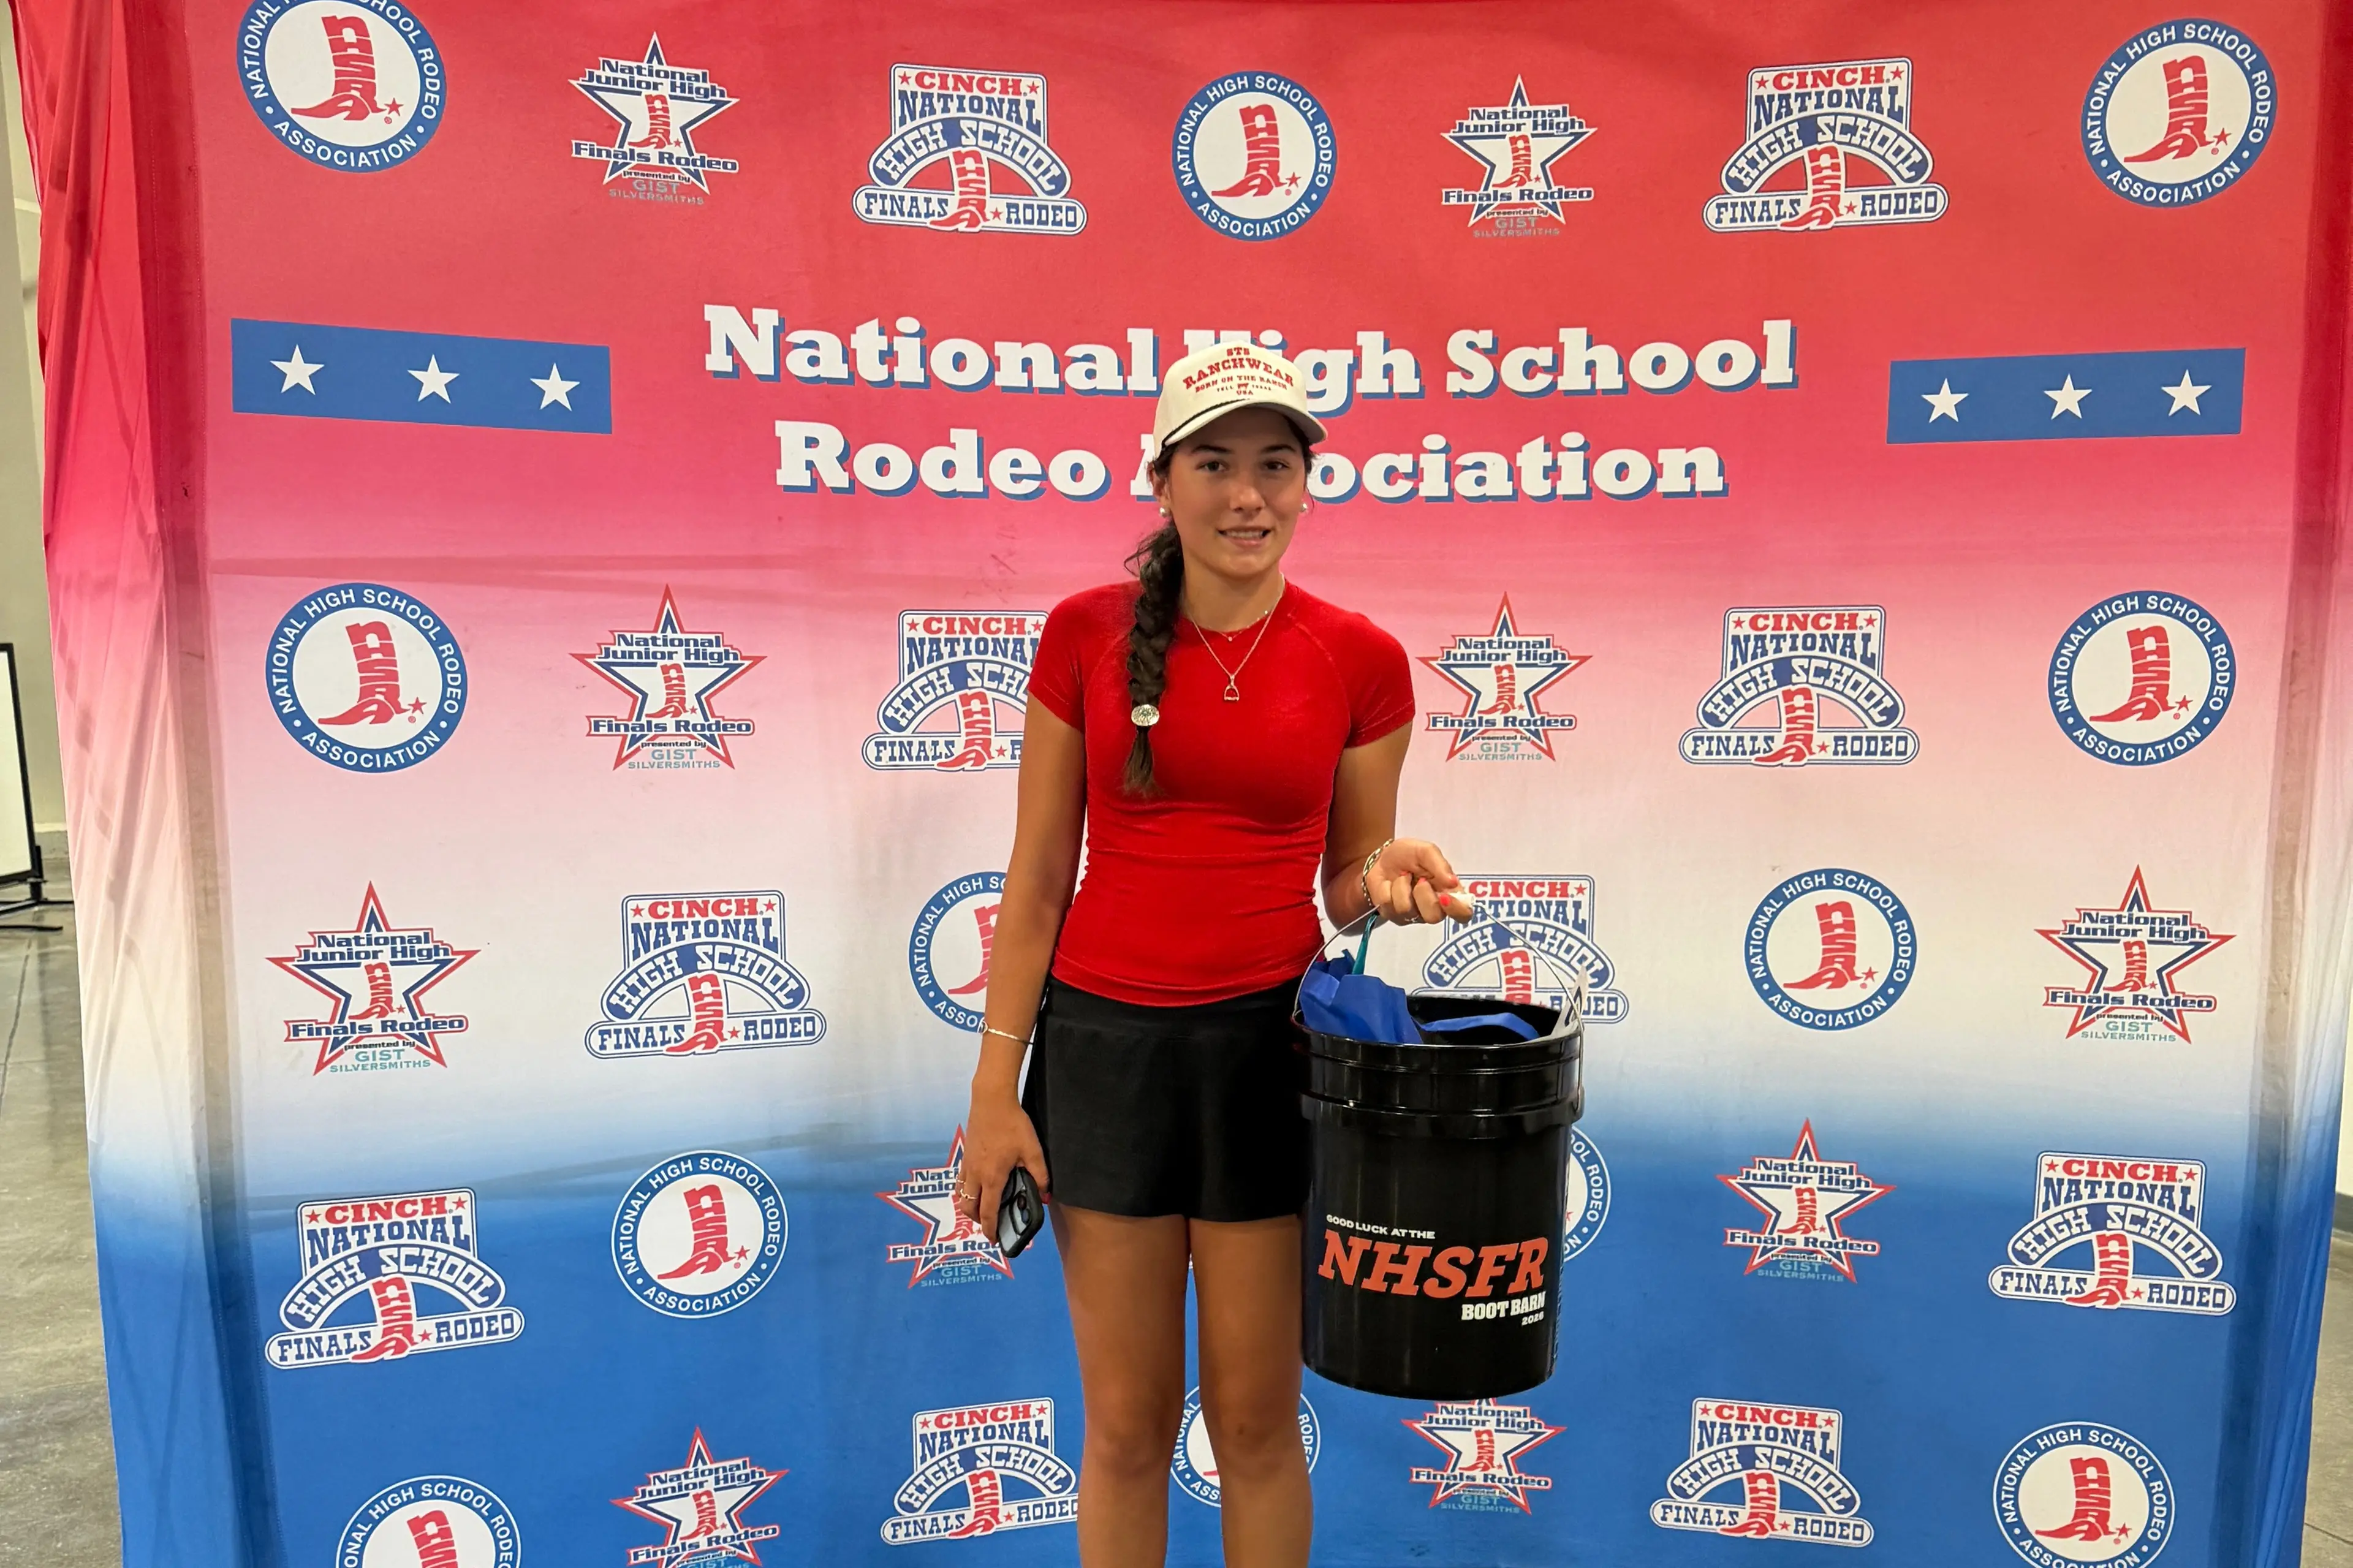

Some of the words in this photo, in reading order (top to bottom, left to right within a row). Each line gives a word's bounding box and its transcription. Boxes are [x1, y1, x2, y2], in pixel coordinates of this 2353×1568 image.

[418, 47, 440, 119] RODEO
[582, 71, 663, 91] Junior
[670, 82, 726, 99] High
[602, 59, 707, 83] National
[915, 70, 1021, 97] CINCH
[1773, 66, 1885, 90] CINCH
[2086, 62, 2126, 155] NATIONAL
[2126, 26, 2175, 59] HIGH
[2183, 24, 2258, 69] SCHOOL
[2249, 70, 2271, 142] RODEO
[898, 89, 1040, 137] NATIONAL
[1471, 107, 1567, 121] National
[1755, 86, 1903, 132] NATIONAL
[1176, 102, 1208, 186] NATIONAL
[1207, 76, 1248, 102] HIGH
[1255, 75, 1318, 121] SCHOOL
[1315, 123, 1332, 187] RODEO
[1453, 123, 1526, 134] Junior
[1533, 119, 1584, 132] High
[273, 121, 417, 166] ASSOCIATION
[575, 142, 650, 162] Finals
[659, 152, 737, 172] Rodeo
[876, 123, 947, 181] HIGH
[960, 120, 1061, 192] SCHOOL
[1729, 123, 1802, 187] HIGH
[1817, 115, 1923, 178] SCHOOL
[1444, 190, 1512, 202] Finals
[1519, 189, 1592, 201] Rodeo
[2107, 162, 2240, 202] ASSOCIATION
[865, 194, 948, 216] FINALS
[1006, 203, 1077, 227] RODEO
[1197, 203, 1311, 236] ASSOCIATION
[1715, 199, 1800, 224] FINALS
[1861, 191, 1938, 216] RODEO
[705, 305, 1158, 391] National
[1447, 320, 1793, 393] School
[1183, 358, 1294, 389] RANCHWEAR
[1195, 379, 1218, 392] BORN
[1259, 376, 1287, 390] RANCH
[775, 422, 1106, 496] Rodeo
[1748, 613, 1859, 631] CINCH
[273, 619, 306, 714] NATIONAL
[304, 589, 355, 618] HIGH
[363, 589, 442, 640] SCHOOL
[439, 643, 461, 713] RODEO
[598, 647, 678, 660] Junior
[684, 650, 738, 664] High
[617, 634, 721, 648] National
[1458, 638, 1551, 649] National
[1730, 634, 1875, 671] NATIONAL
[2053, 626, 2091, 712] NATIONAL
[2091, 597, 2139, 624] HIGH
[2146, 596, 2218, 642] SCHOOL
[2209, 644, 2230, 710] RODEO
[1440, 651, 1510, 661] Junior
[1517, 651, 1567, 664] High
[1705, 664, 1777, 722] HIGH
[1792, 659, 1894, 722] SCHOOL
[594, 720, 667, 732] Finals
[675, 721, 751, 732] Rodeo
[1431, 716, 1497, 727] Finals
[1504, 716, 1573, 727] Rodeo
[303, 731, 440, 768] ASSOCIATION
[651, 749, 696, 760] GIST
[1691, 736, 1775, 756] FINALS
[1833, 736, 1908, 756] RODEO
[2073, 727, 2201, 761] ASSOCIATION
[648, 898, 758, 919] CINCH
[2083, 912, 2188, 926] National
[317, 932, 430, 947] National
[631, 918, 778, 960] NATIONAL
[1749, 899, 1783, 979] NATIONAL
[1783, 874, 1826, 898] HIGH
[1833, 873, 1899, 918] SCHOOL
[1893, 920, 1912, 982] RODEO
[2062, 924, 2142, 937] Junior
[2149, 928, 2206, 941] High
[297, 950, 383, 962] Junior
[391, 945, 449, 960] High
[610, 951, 683, 1014] HIGH
[695, 945, 799, 1005] SCHOOL
[1769, 994, 1887, 1026] ASSOCIATION
[2051, 991, 2125, 1005] Finals
[2132, 994, 2213, 1009] Rodeo
[292, 1022, 373, 1037] Finals
[381, 1018, 464, 1032] Rodeo
[599, 1025, 684, 1050] FINALS
[744, 1017, 816, 1040] RODEO
[2082, 1031, 2176, 1042] SILVERSMITHS
[2105, 1020, 2153, 1032] GIST
[330, 1060, 430, 1072] SILVERSMITHS
[355, 1049, 404, 1062] GIST
[1740, 1170, 1812, 1184] Junior
[1819, 1176, 1871, 1190] High
[1758, 1159, 1854, 1175] National
[2062, 1159, 2178, 1183] CINCH
[324, 1196, 446, 1225] CINCH
[2043, 1176, 2194, 1222] NATIONAL
[620, 1191, 650, 1274] NATIONAL
[649, 1159, 692, 1189] HIGH
[699, 1157, 765, 1195] SCHOOL
[762, 1195, 780, 1256] RODEO
[1326, 1214, 1354, 1229] GOOD
[1355, 1222, 1387, 1235] LUCK
[1391, 1228, 1408, 1237] AT
[1408, 1229, 1436, 1239] THE
[306, 1216, 470, 1268] NATIONAL
[1729, 1231, 1797, 1246] Finals
[1804, 1237, 1877, 1252] Rodeo
[2015, 1208, 2091, 1261] HIGH
[2107, 1205, 2213, 1274] SCHOOL
[1317, 1229, 1548, 1299] NHSFR
[287, 1256, 366, 1323] HIGH
[379, 1246, 494, 1304] SCHOOL
[644, 1273, 760, 1311] ASSOCIATION
[2000, 1271, 2087, 1294] FINALS
[2148, 1283, 2227, 1308] RODEO
[1461, 1300, 1509, 1320] BOOT
[1510, 1290, 1547, 1316] BARN
[1521, 1311, 1544, 1326] 2026
[277, 1330, 371, 1362] FINALS
[436, 1314, 515, 1343] RODEO
[934, 1404, 1031, 1430] CINCH
[1714, 1404, 1818, 1429] CINCH
[919, 1420, 1048, 1464] NATIONAL
[1697, 1420, 1833, 1464] NATIONAL
[900, 1454, 964, 1509] HIGH
[976, 1445, 1067, 1491] SCHOOL
[1673, 1449, 1741, 1495] HIGH
[1756, 1447, 1851, 1510] SCHOOL
[2001, 1449, 2037, 1523] NATIONAL
[2037, 1430, 2081, 1449] HIGH
[2088, 1430, 2155, 1479] SCHOOL
[2148, 1482, 2167, 1540] RODEO
[891, 1513, 965, 1539] FINALS
[1661, 1504, 1739, 1526] FINALS
[1794, 1517, 1864, 1541] RODEO
